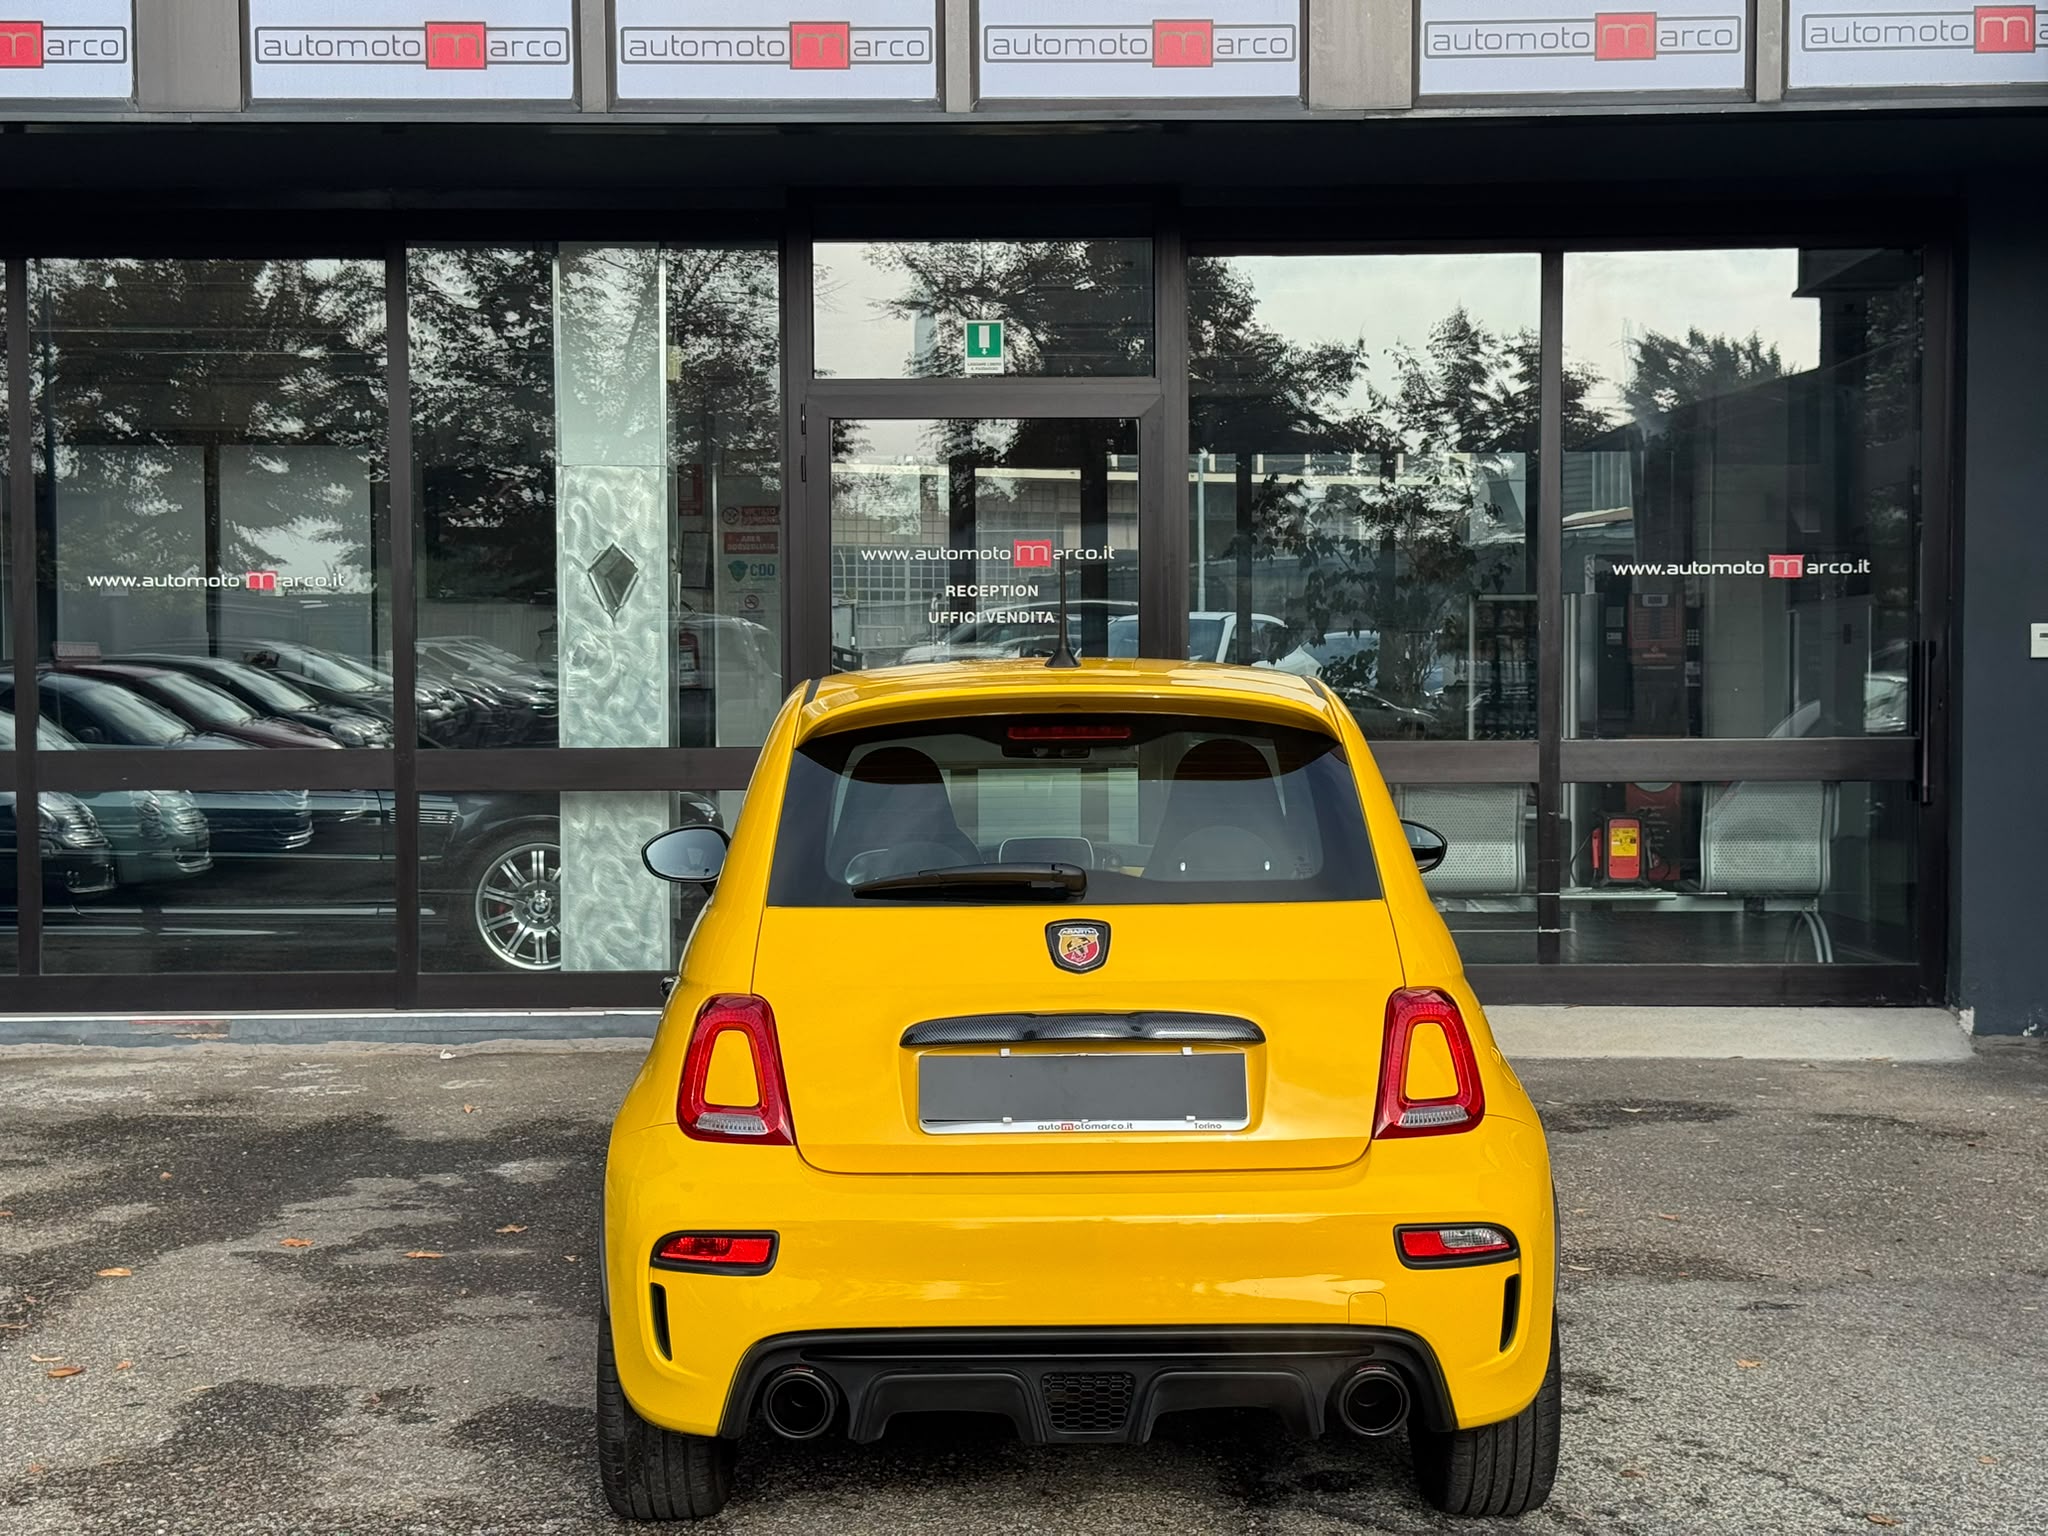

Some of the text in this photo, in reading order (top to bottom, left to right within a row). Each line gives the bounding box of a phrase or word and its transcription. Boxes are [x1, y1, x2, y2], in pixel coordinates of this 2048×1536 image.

[945, 585, 1039, 598] RECEPTION
[928, 610, 1055, 624] UFFICI VENDITA
[1194, 1122, 1222, 1130] Torino
